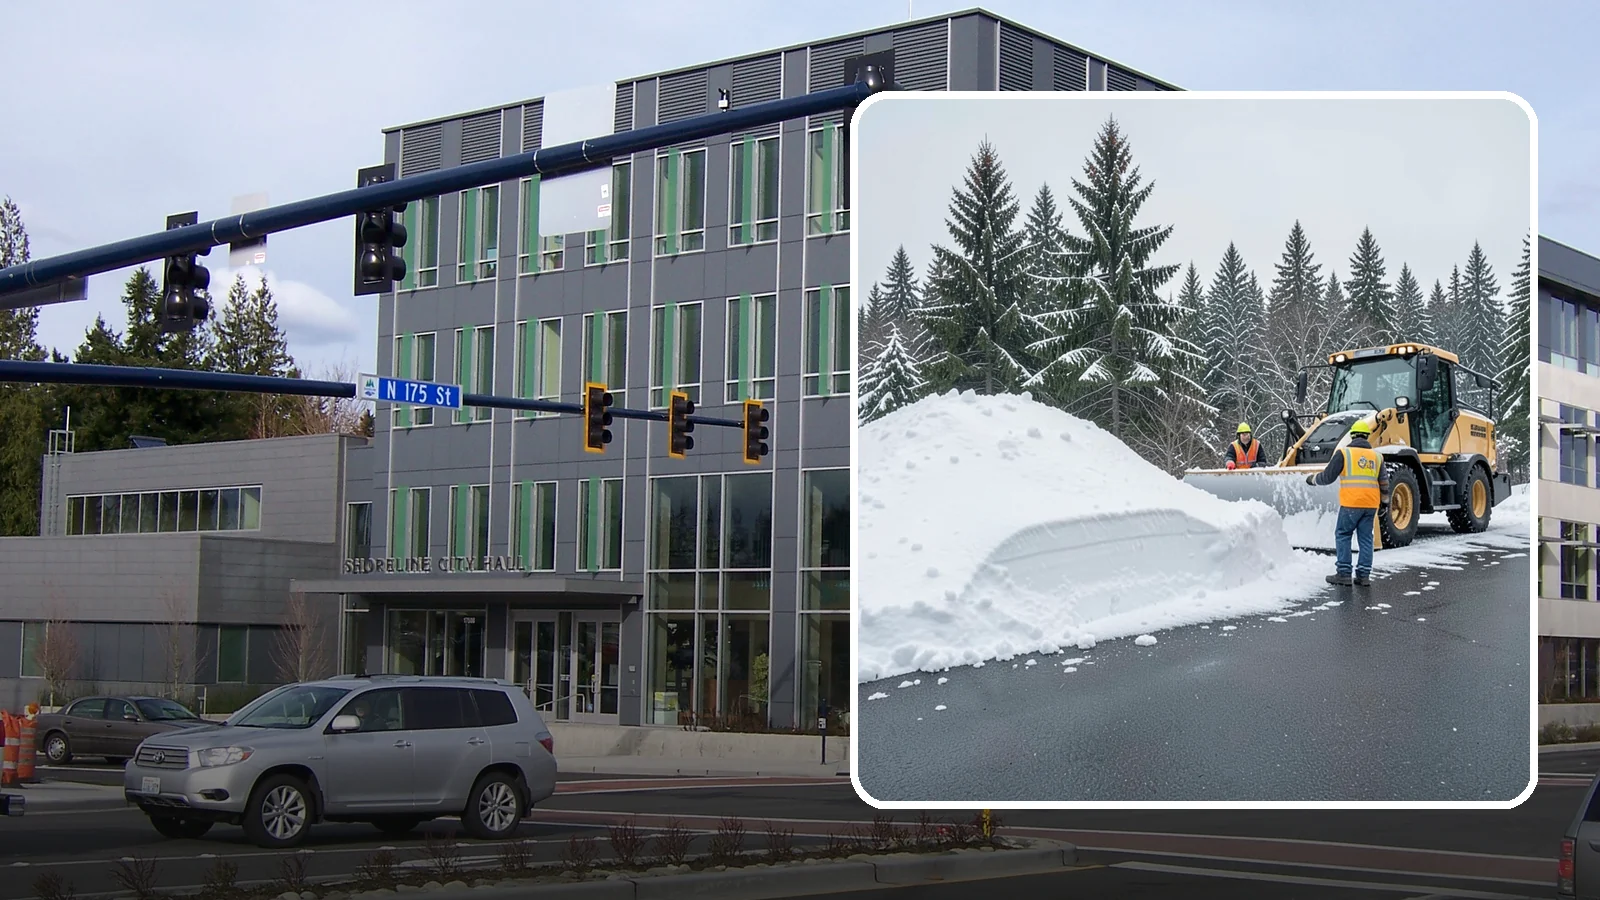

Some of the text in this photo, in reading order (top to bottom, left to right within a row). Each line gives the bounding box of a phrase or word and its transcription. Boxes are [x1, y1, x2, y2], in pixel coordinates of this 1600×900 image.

[387, 381, 451, 406] N 175 St
[344, 555, 525, 574] SHORELINE CITY HALL
